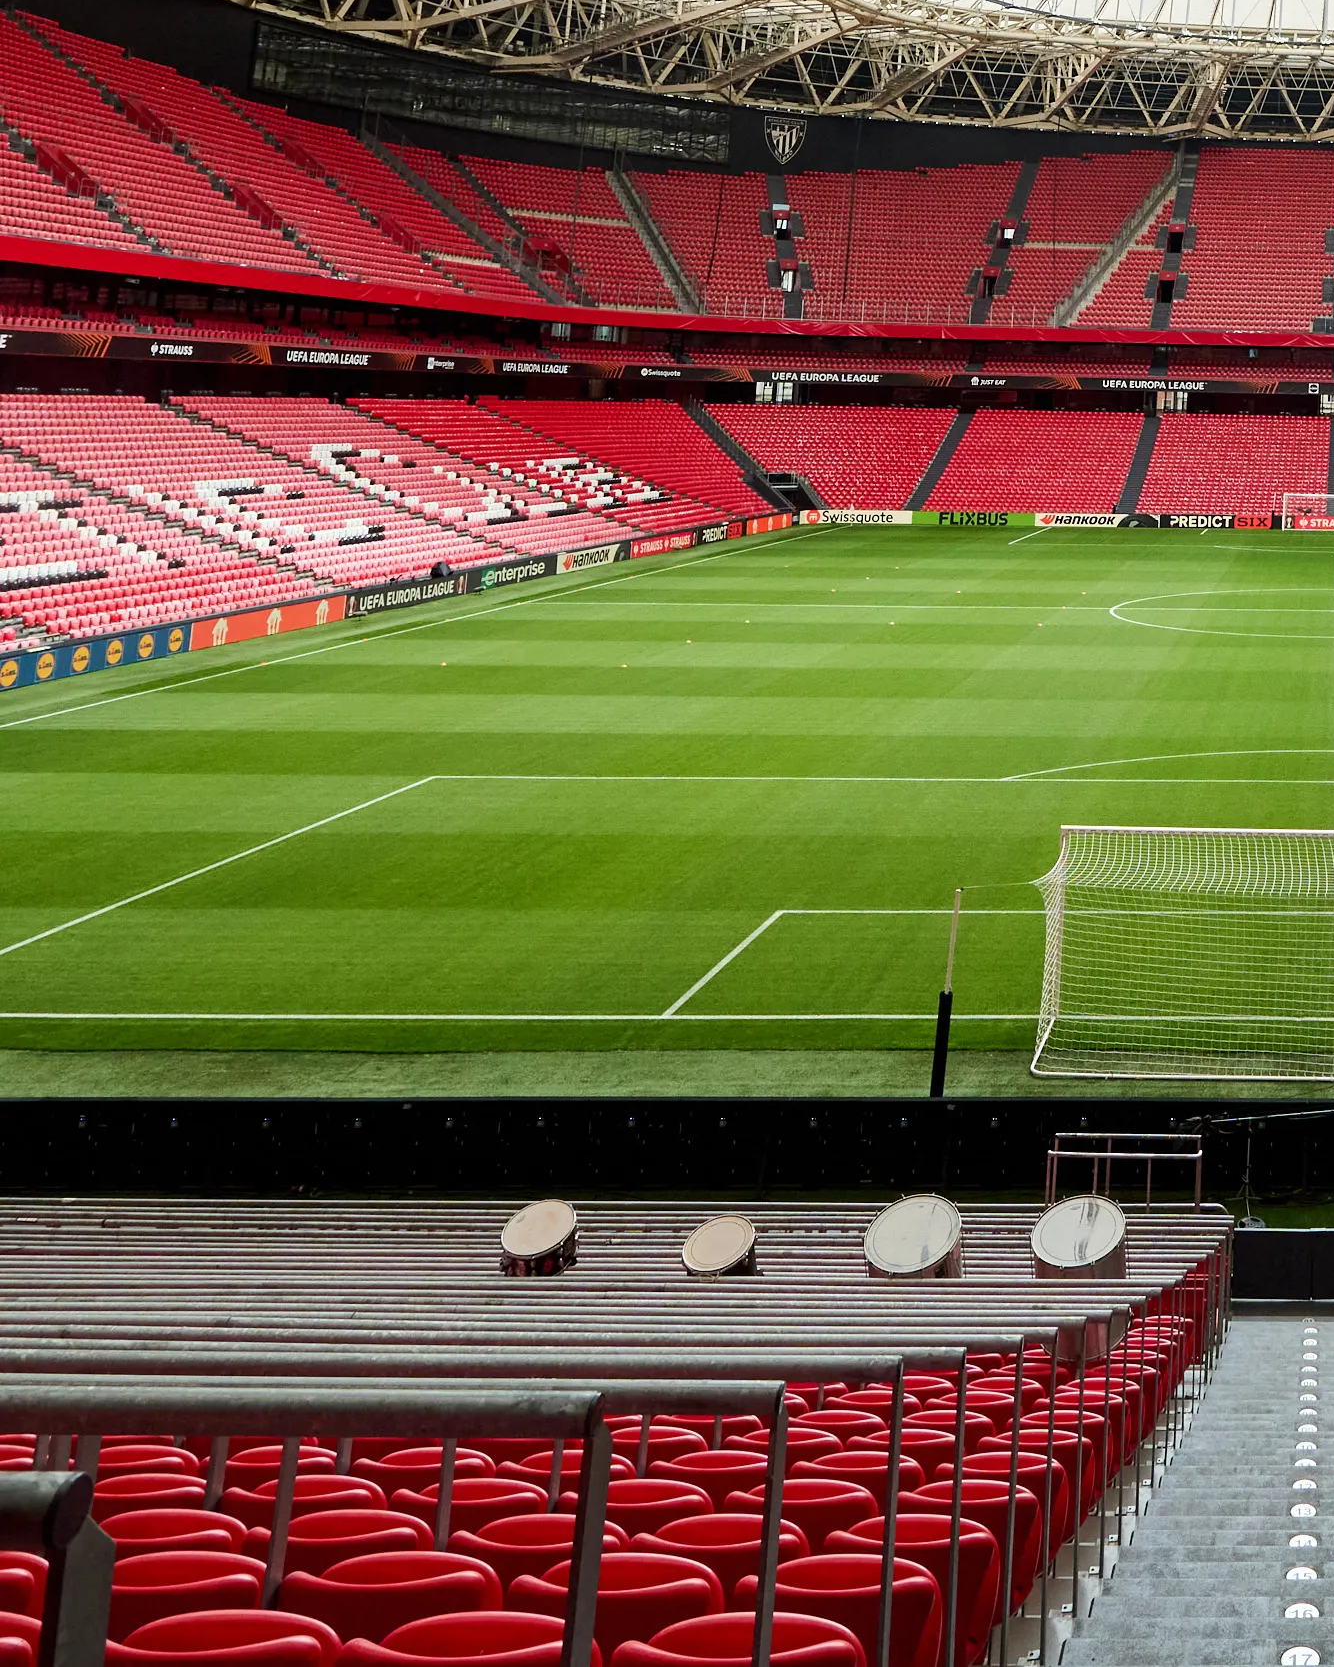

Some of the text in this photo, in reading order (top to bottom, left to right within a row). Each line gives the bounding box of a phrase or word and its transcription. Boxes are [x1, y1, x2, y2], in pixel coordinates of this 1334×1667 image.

[159, 344, 193, 356] STRAUSS
[286, 350, 308, 362] UEFA
[308, 351, 339, 365] EUROPA
[502, 361, 517, 372] UEFA
[517, 362, 541, 373] EUROPA
[647, 368, 681, 377] Swissquote
[771, 371, 799, 381] UEFA
[800, 372, 840, 382] EUROPA
[980, 378, 1006, 386] JUST EAT
[1102, 378, 1128, 389] UEFA
[1129, 379, 1167, 390] EUROPA
[822, 510, 894, 525] Swissquote
[1170, 515, 1268, 528] PREDICT SIX
[702, 522, 742, 543] PREDICT SIX
[639, 534, 691, 554] STRAUSS STRAUSS
[482, 560, 546, 587] enterprise
[359, 579, 455, 611] UEFA EUROPA LEAGUE
[1292, 1609, 1313, 1618] 16
[1289, 1653, 1313, 1666] 17
